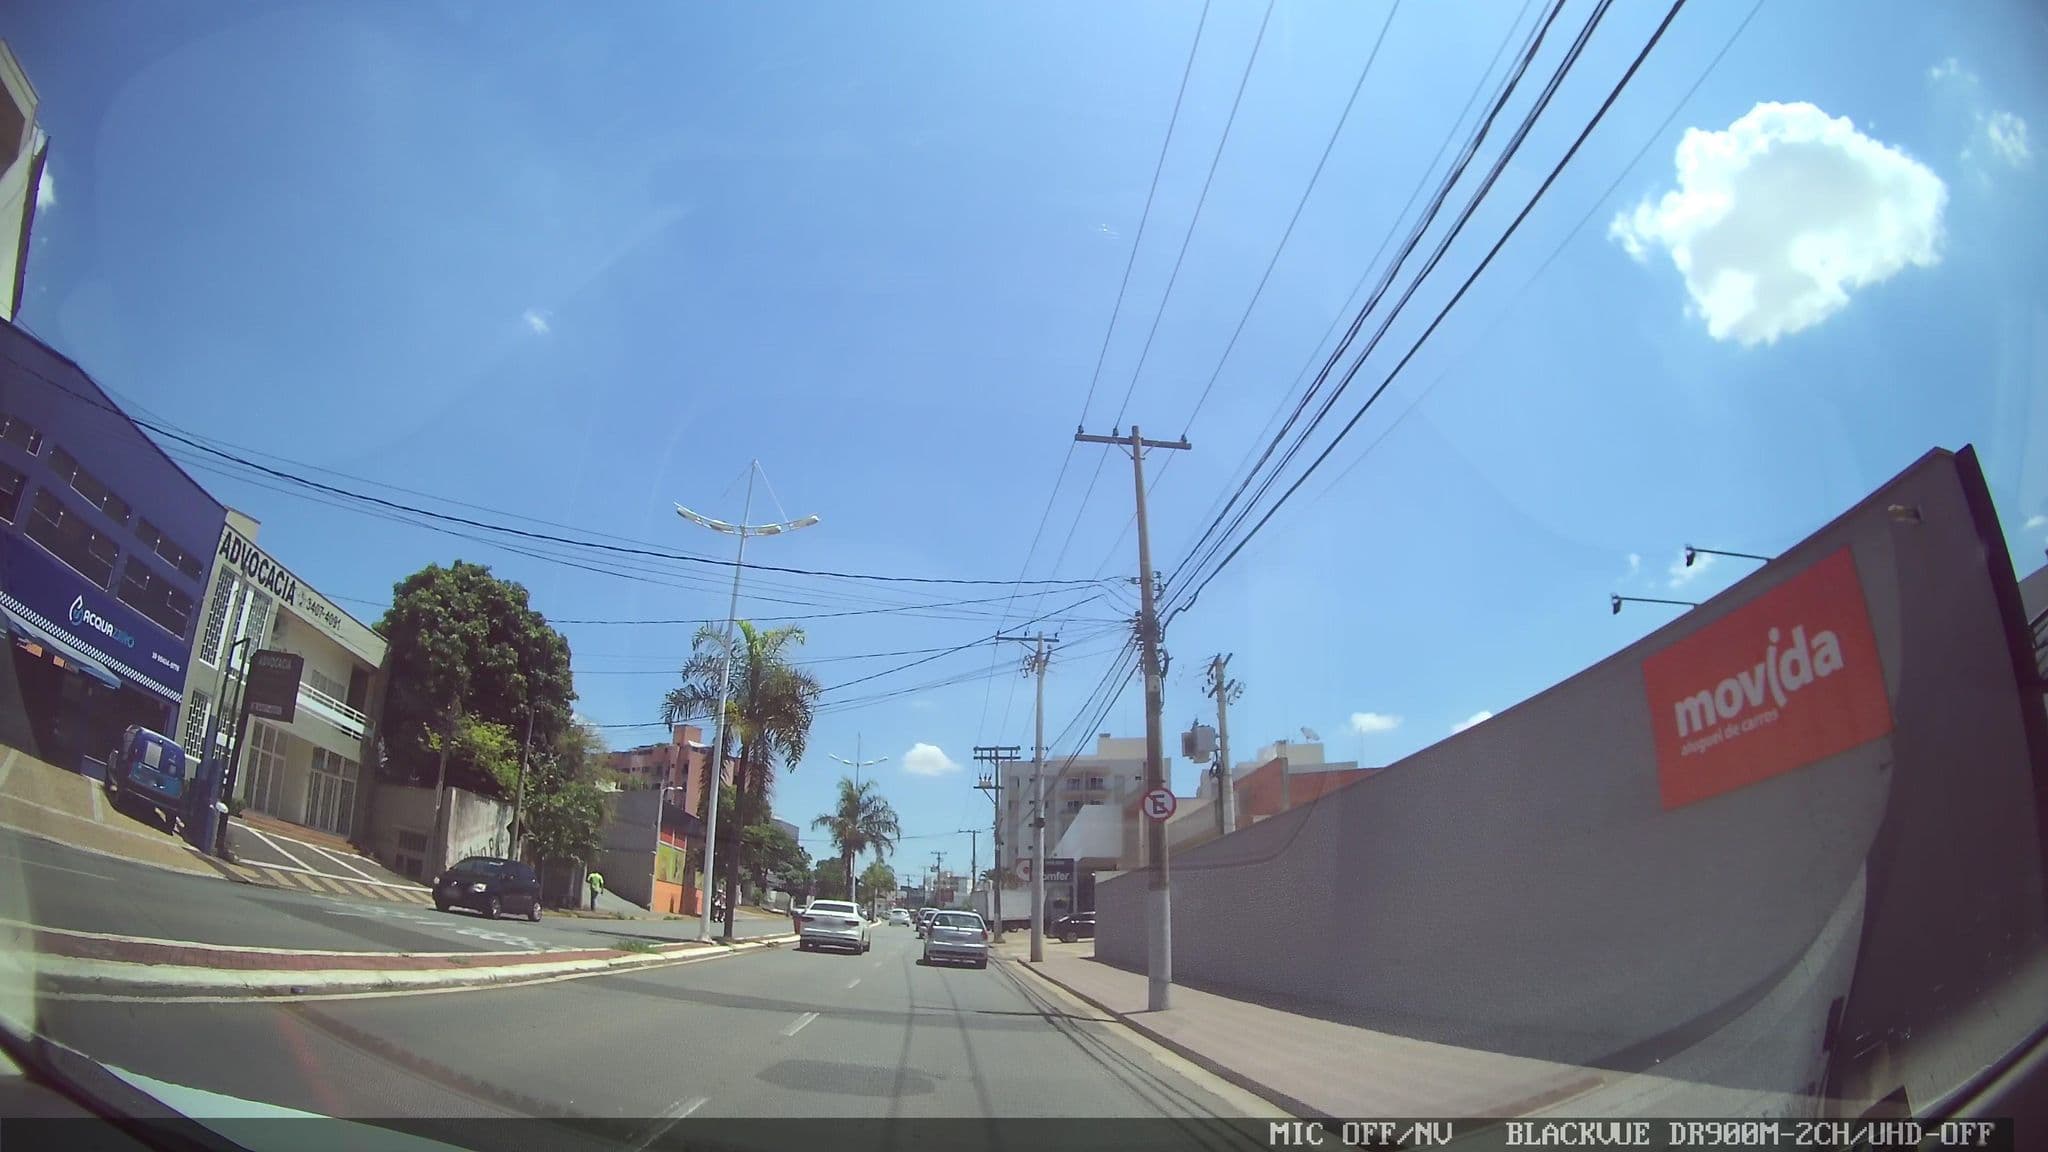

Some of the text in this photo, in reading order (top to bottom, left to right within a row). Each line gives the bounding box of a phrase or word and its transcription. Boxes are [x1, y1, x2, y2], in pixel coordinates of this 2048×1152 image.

[219, 531, 296, 606] ADVOCACIA
[1675, 624, 1844, 737] movida
[1152, 794, 1165, 814] E
